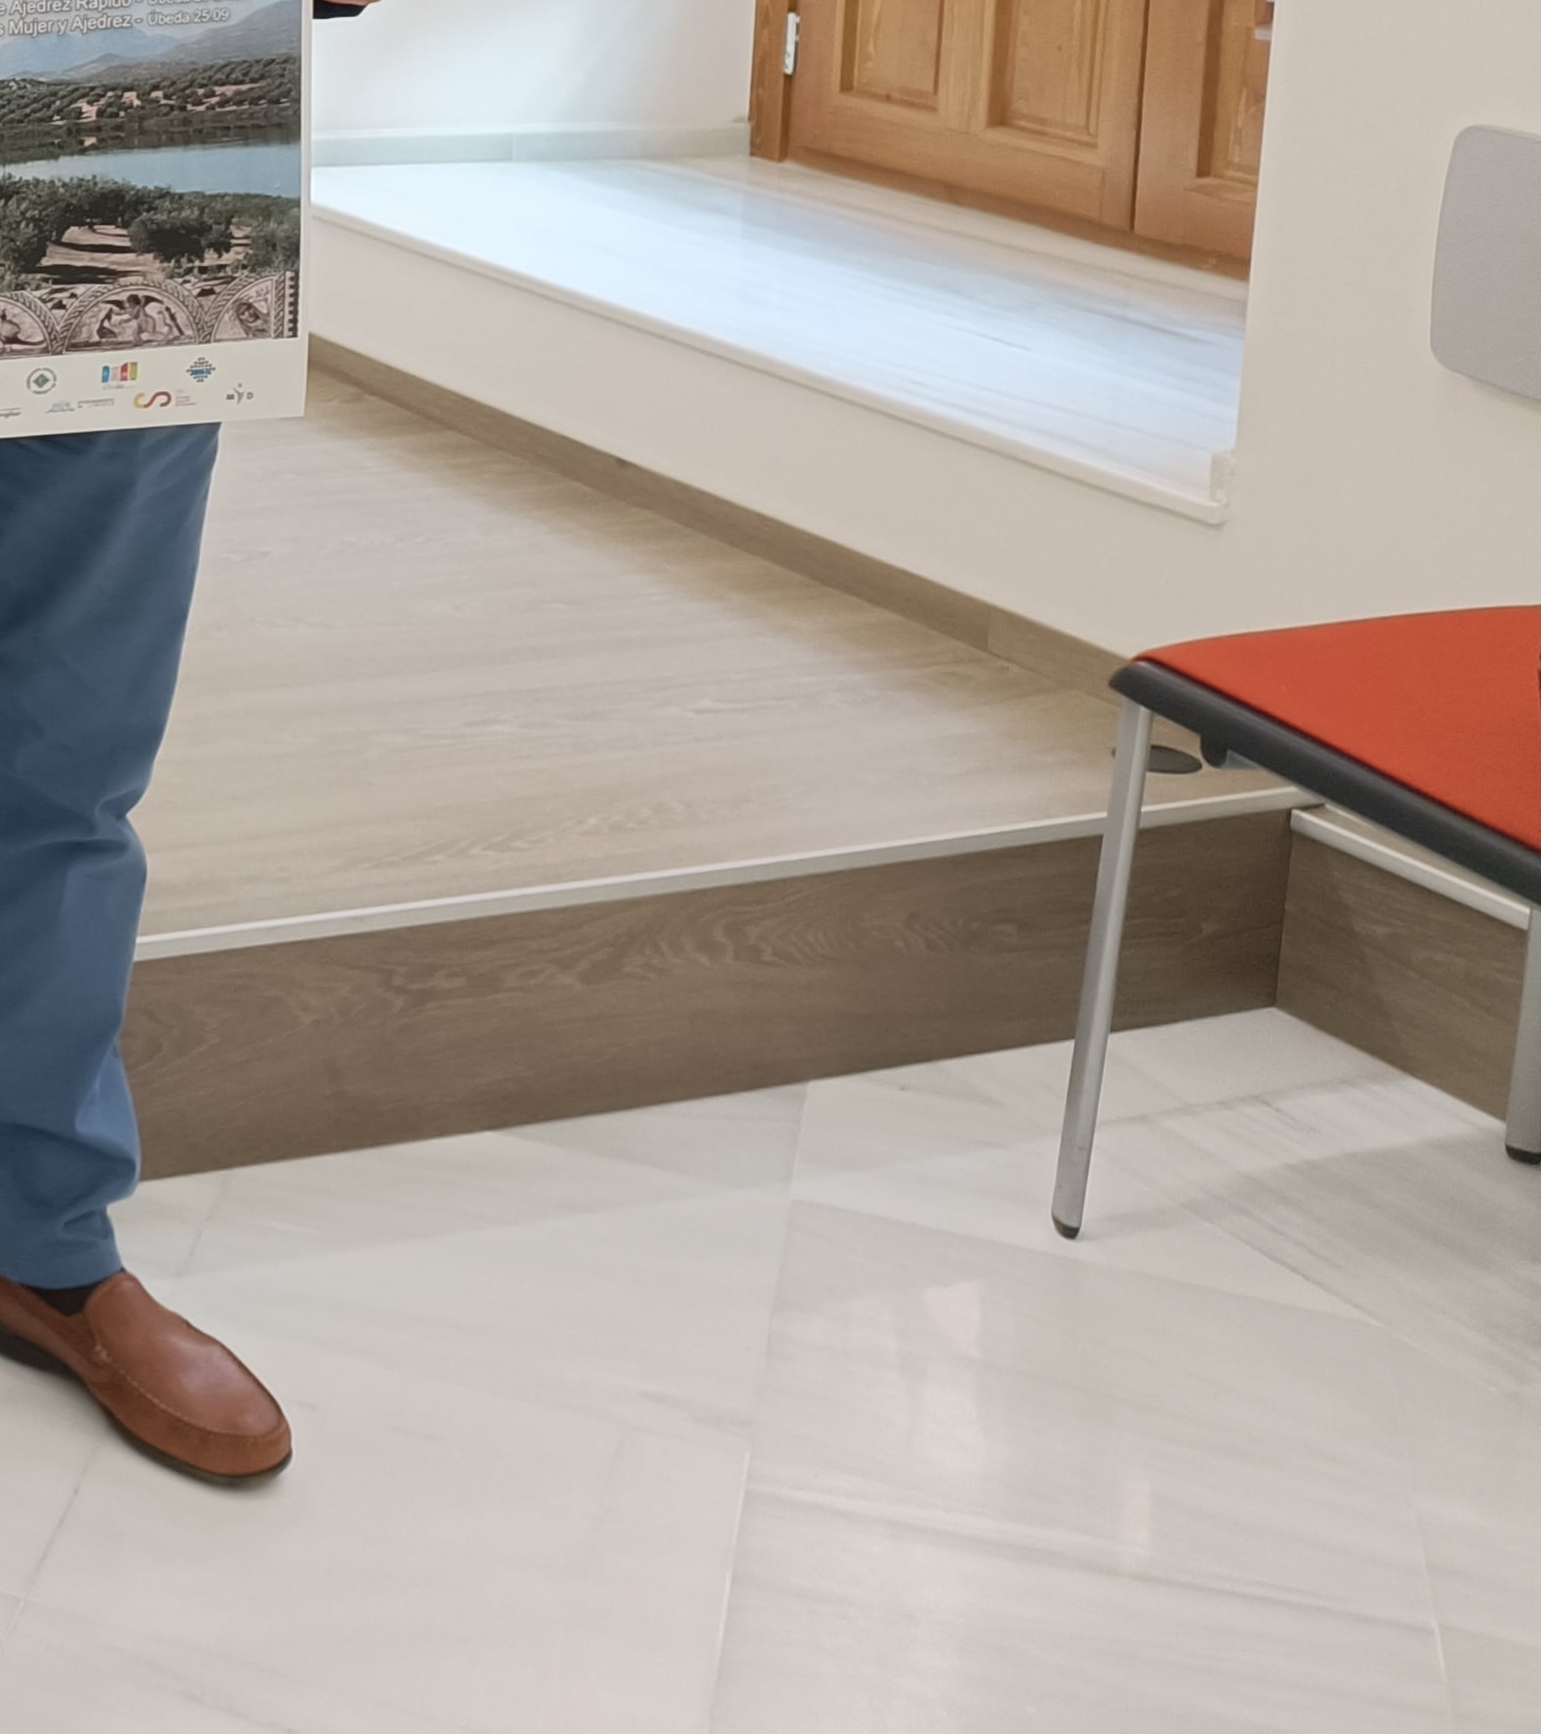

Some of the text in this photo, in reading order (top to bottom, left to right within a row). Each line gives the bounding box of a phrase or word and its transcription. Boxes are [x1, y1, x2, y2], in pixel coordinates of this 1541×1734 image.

[8, 17, 54, 38] Mujer
[57, 21, 67, 36] y
[70, 12, 133, 34] Ajedrez
